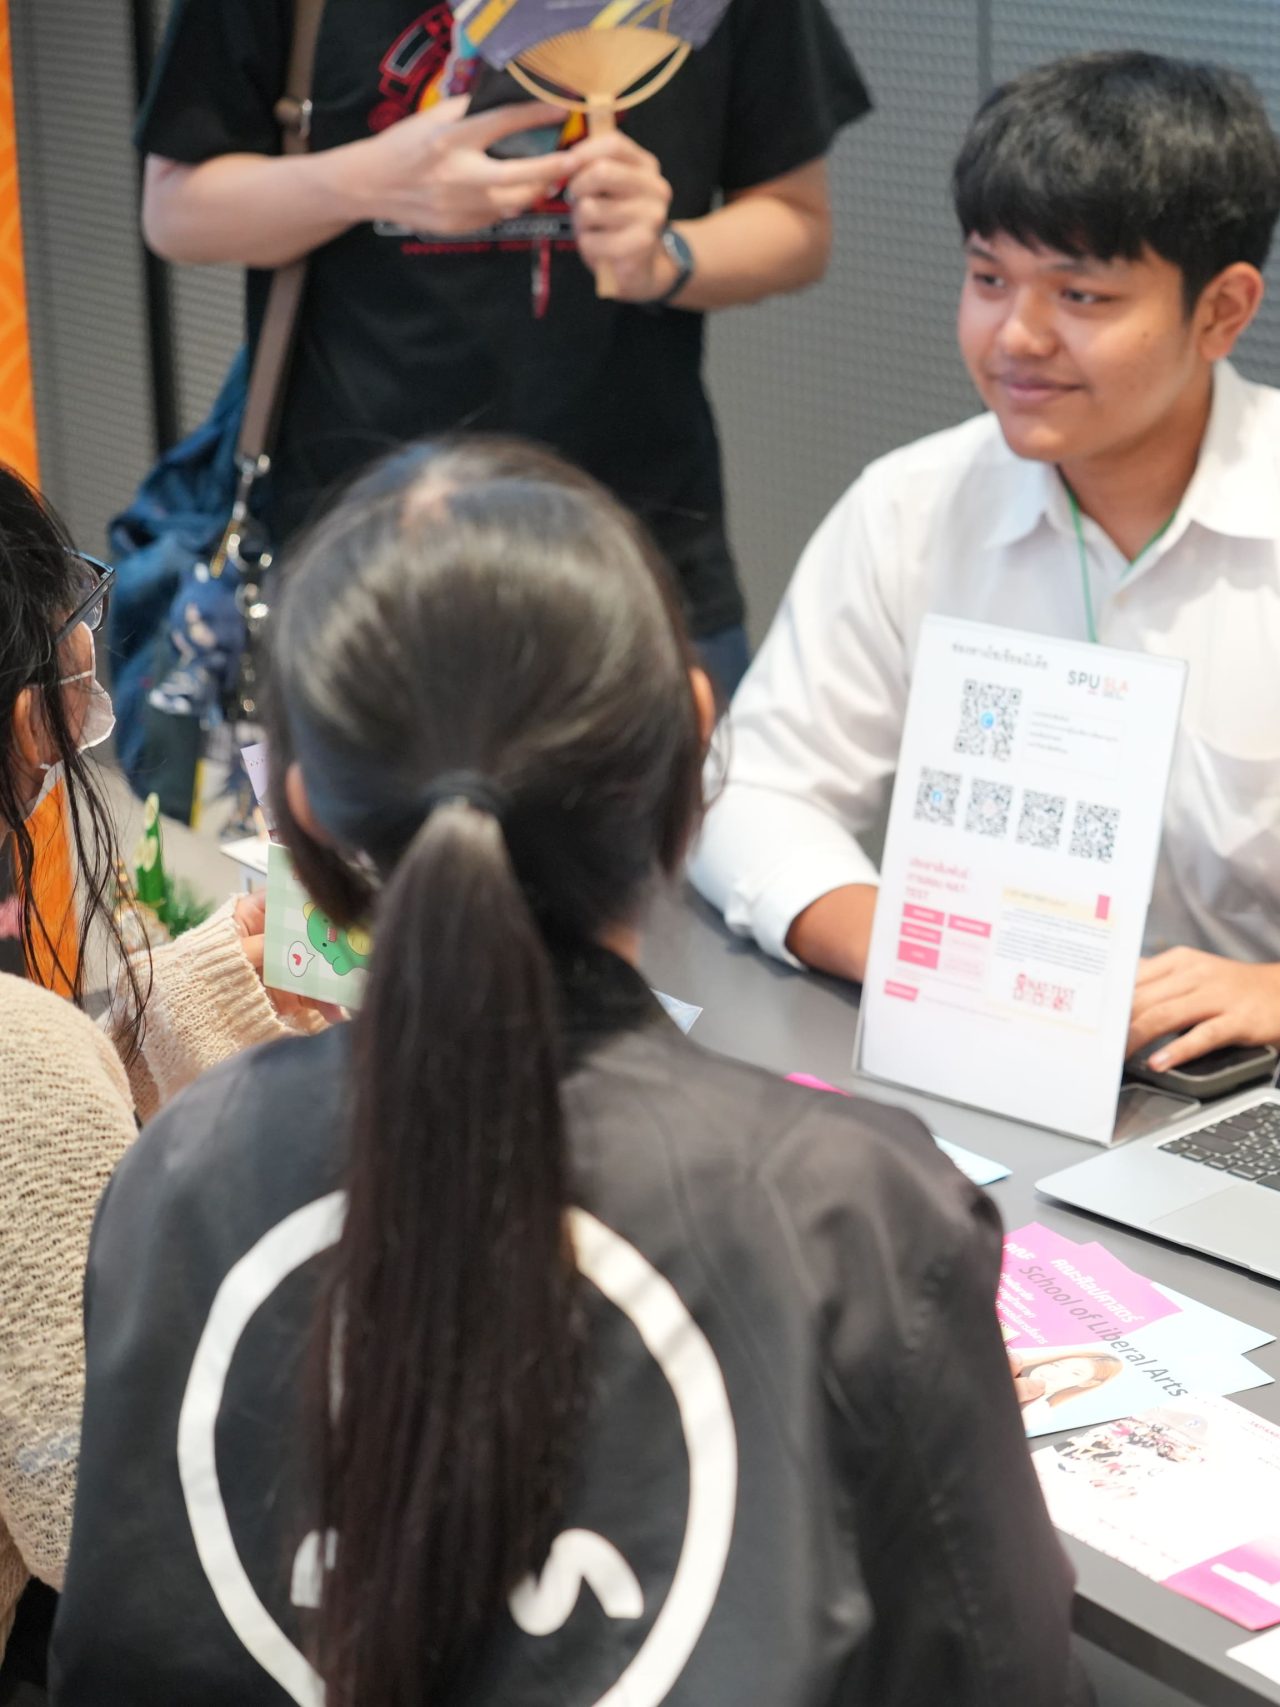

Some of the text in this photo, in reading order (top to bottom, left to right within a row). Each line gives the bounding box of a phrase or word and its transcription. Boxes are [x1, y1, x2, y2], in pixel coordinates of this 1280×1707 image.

[1067, 669, 1100, 690] SPU
[1018, 1264, 1083, 1307] School
[1069, 1305, 1100, 1321] of
[1088, 1319, 1159, 1367] Liberal
[1141, 1366, 1189, 1398] Arts
